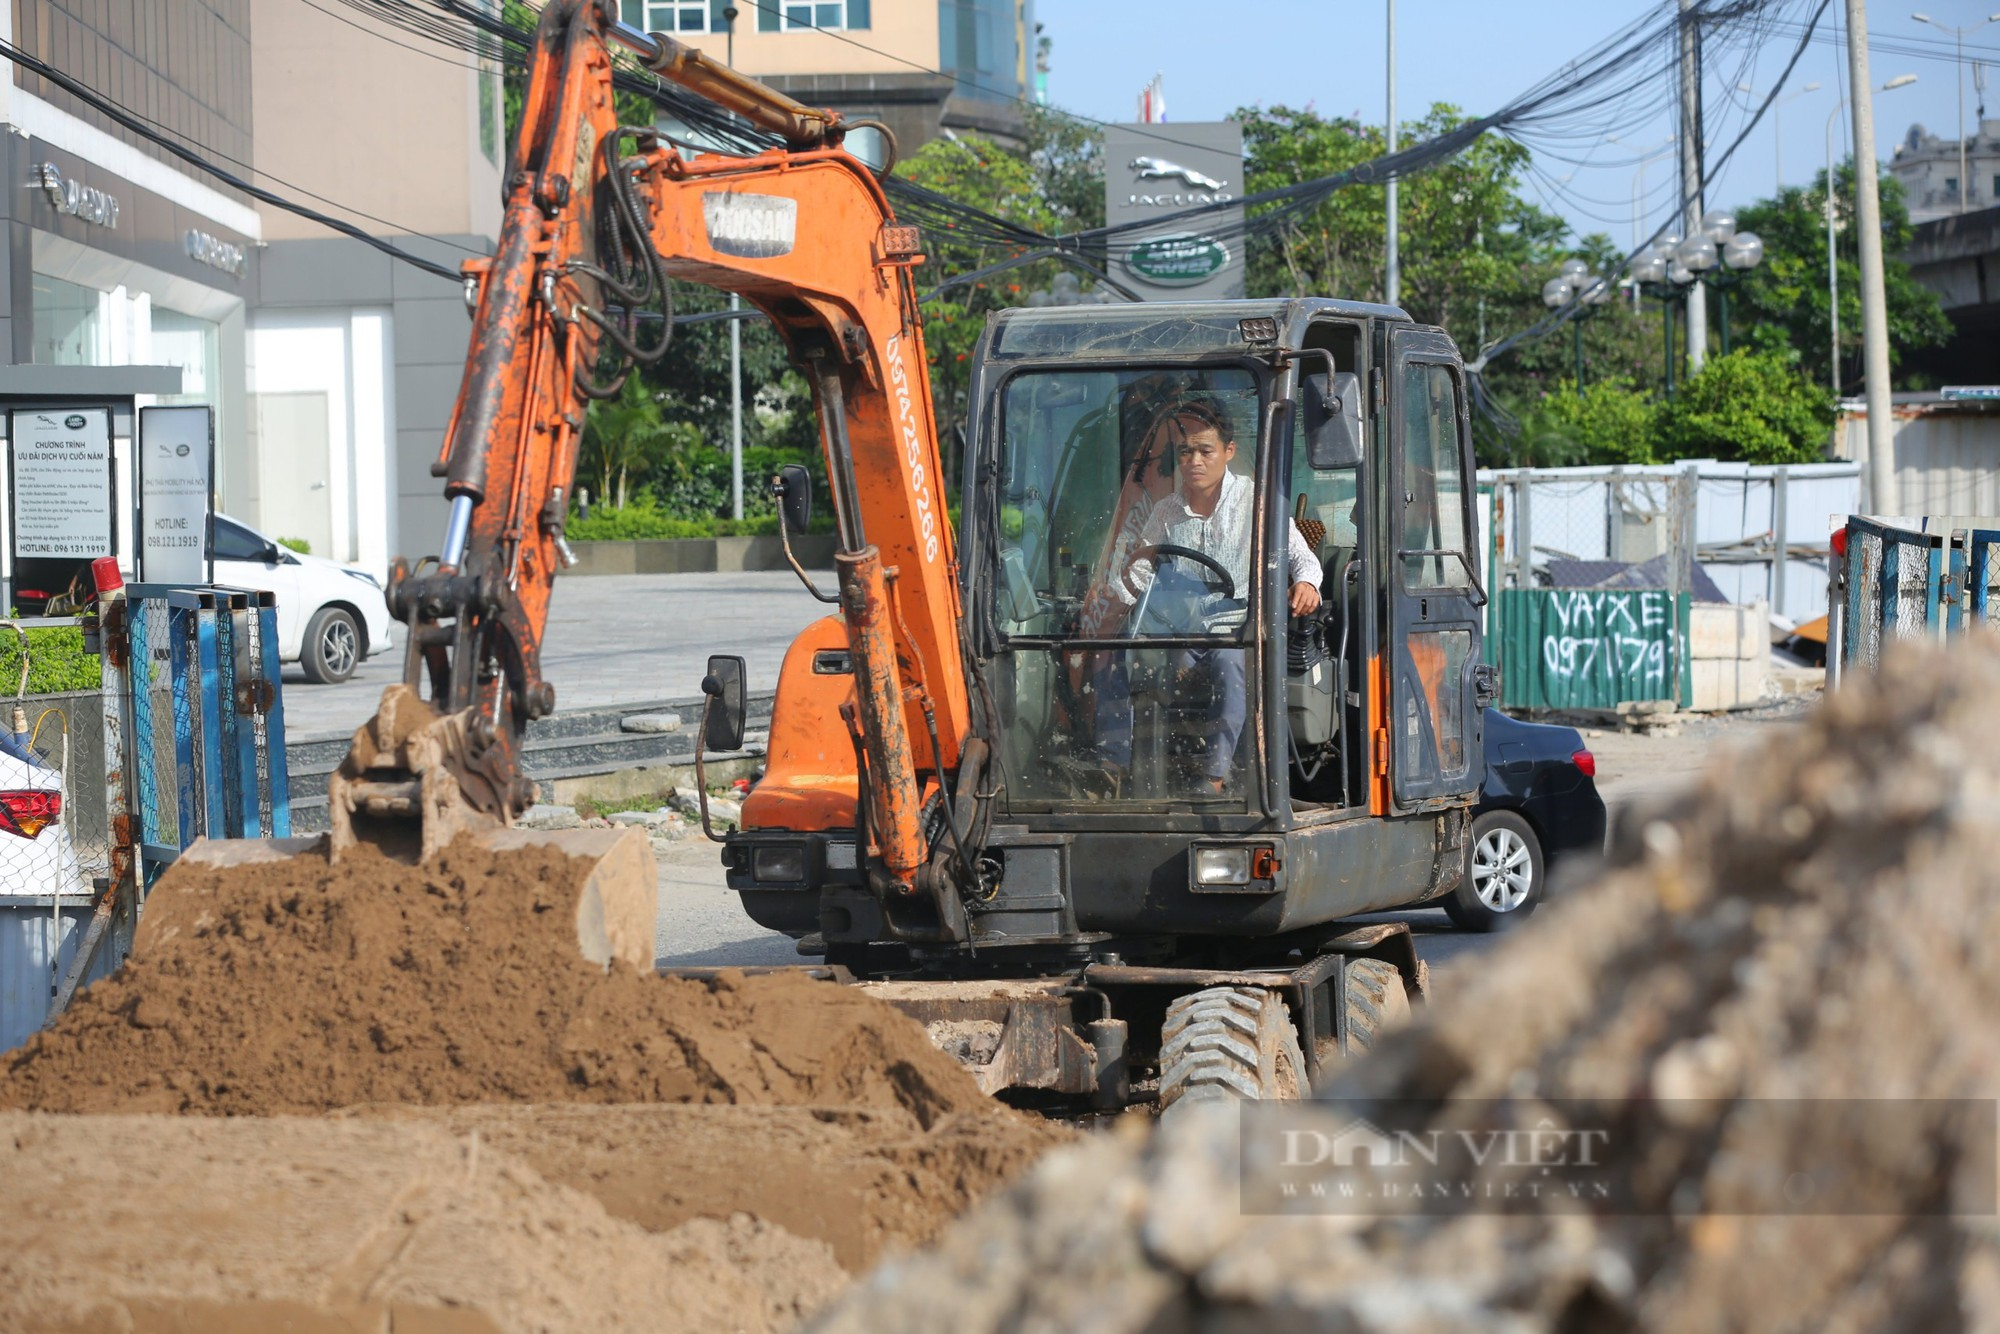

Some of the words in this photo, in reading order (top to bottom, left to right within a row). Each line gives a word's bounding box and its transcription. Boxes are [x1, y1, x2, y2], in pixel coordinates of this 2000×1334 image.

[35, 441, 64, 449] CHƯƠNG
[65, 439, 86, 449] TRÌNH
[41, 452, 58, 462] DỊCH
[58, 452, 68, 462] VỤ
[155, 518, 189, 530] HOTLINE:
[20, 543, 53, 552] HOTLINE:
[54, 544, 69, 553] 096
[70, 545, 84, 553] 131
[86, 545, 106, 553] 1919
